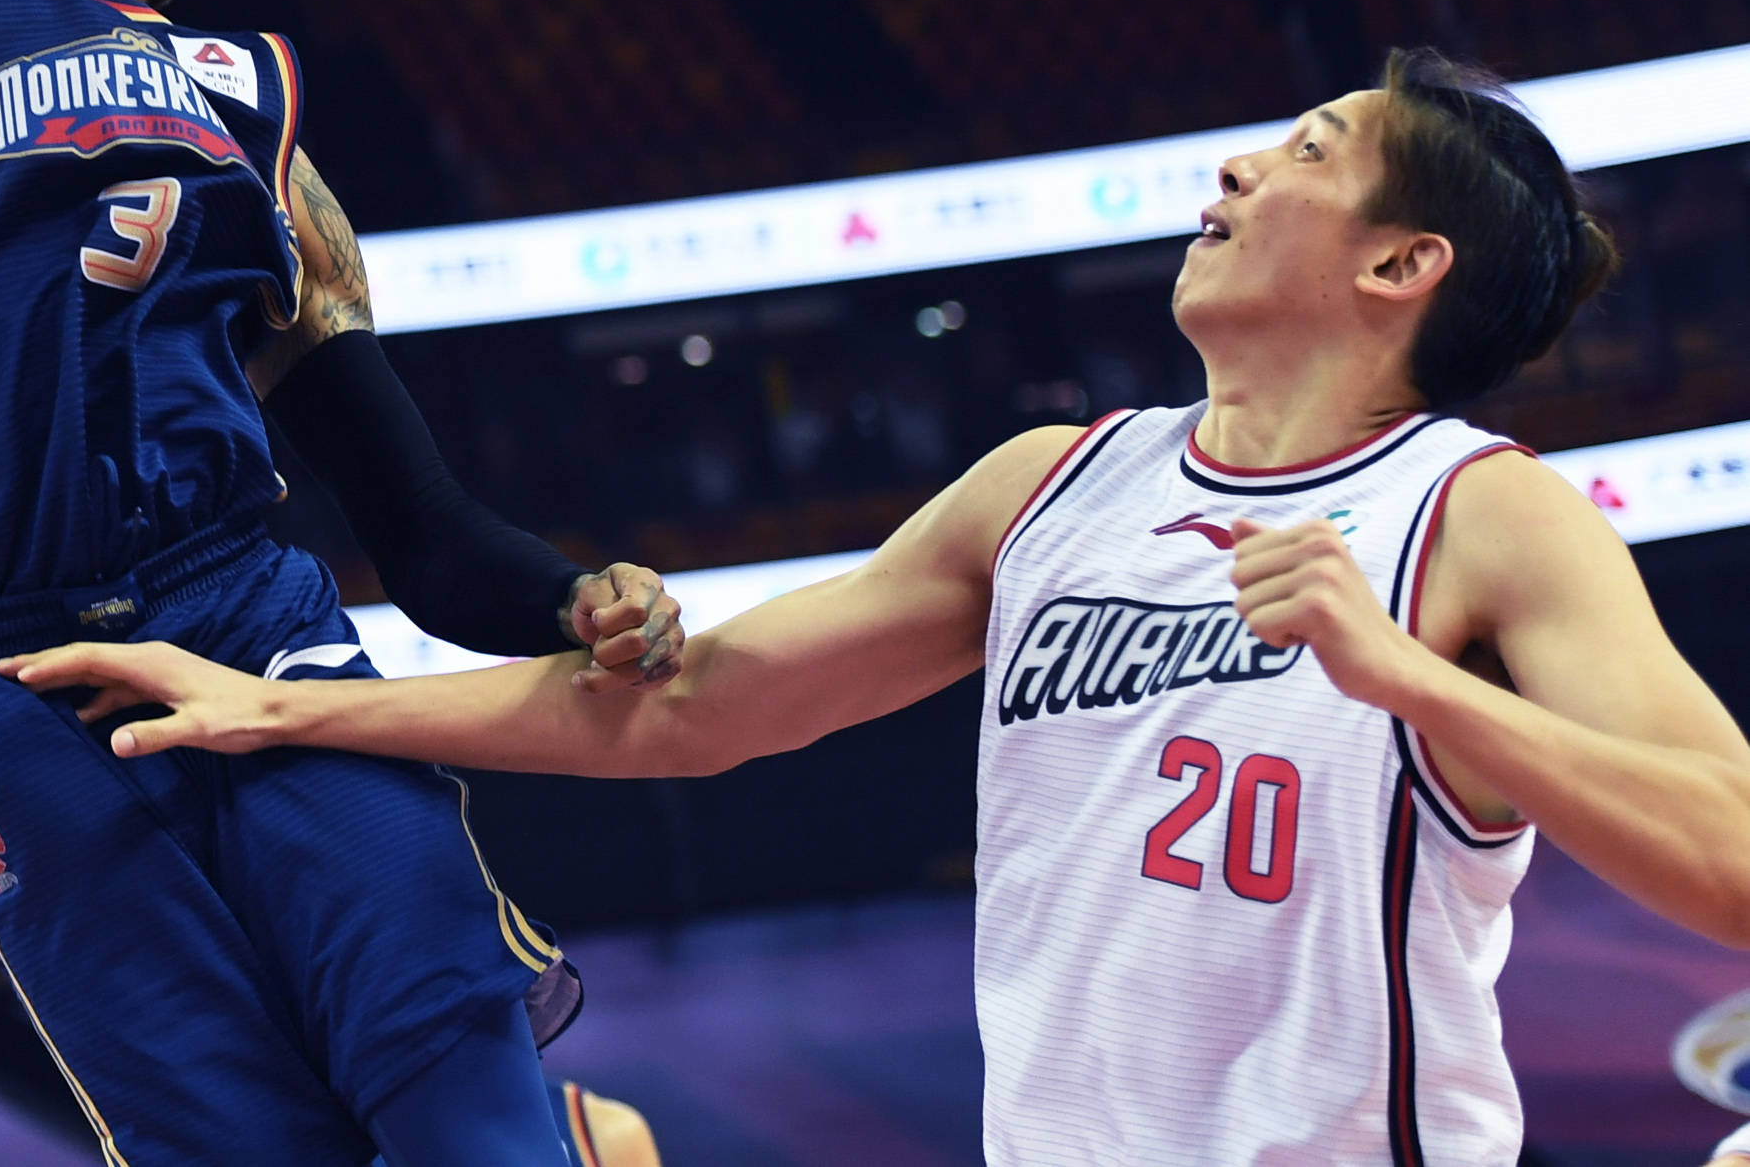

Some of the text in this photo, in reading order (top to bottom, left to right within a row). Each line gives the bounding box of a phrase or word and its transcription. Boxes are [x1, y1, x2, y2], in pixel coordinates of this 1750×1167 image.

[100, 117, 201, 141] NANJING
[79, 176, 182, 293] 3
[1140, 734, 1302, 904] 20
